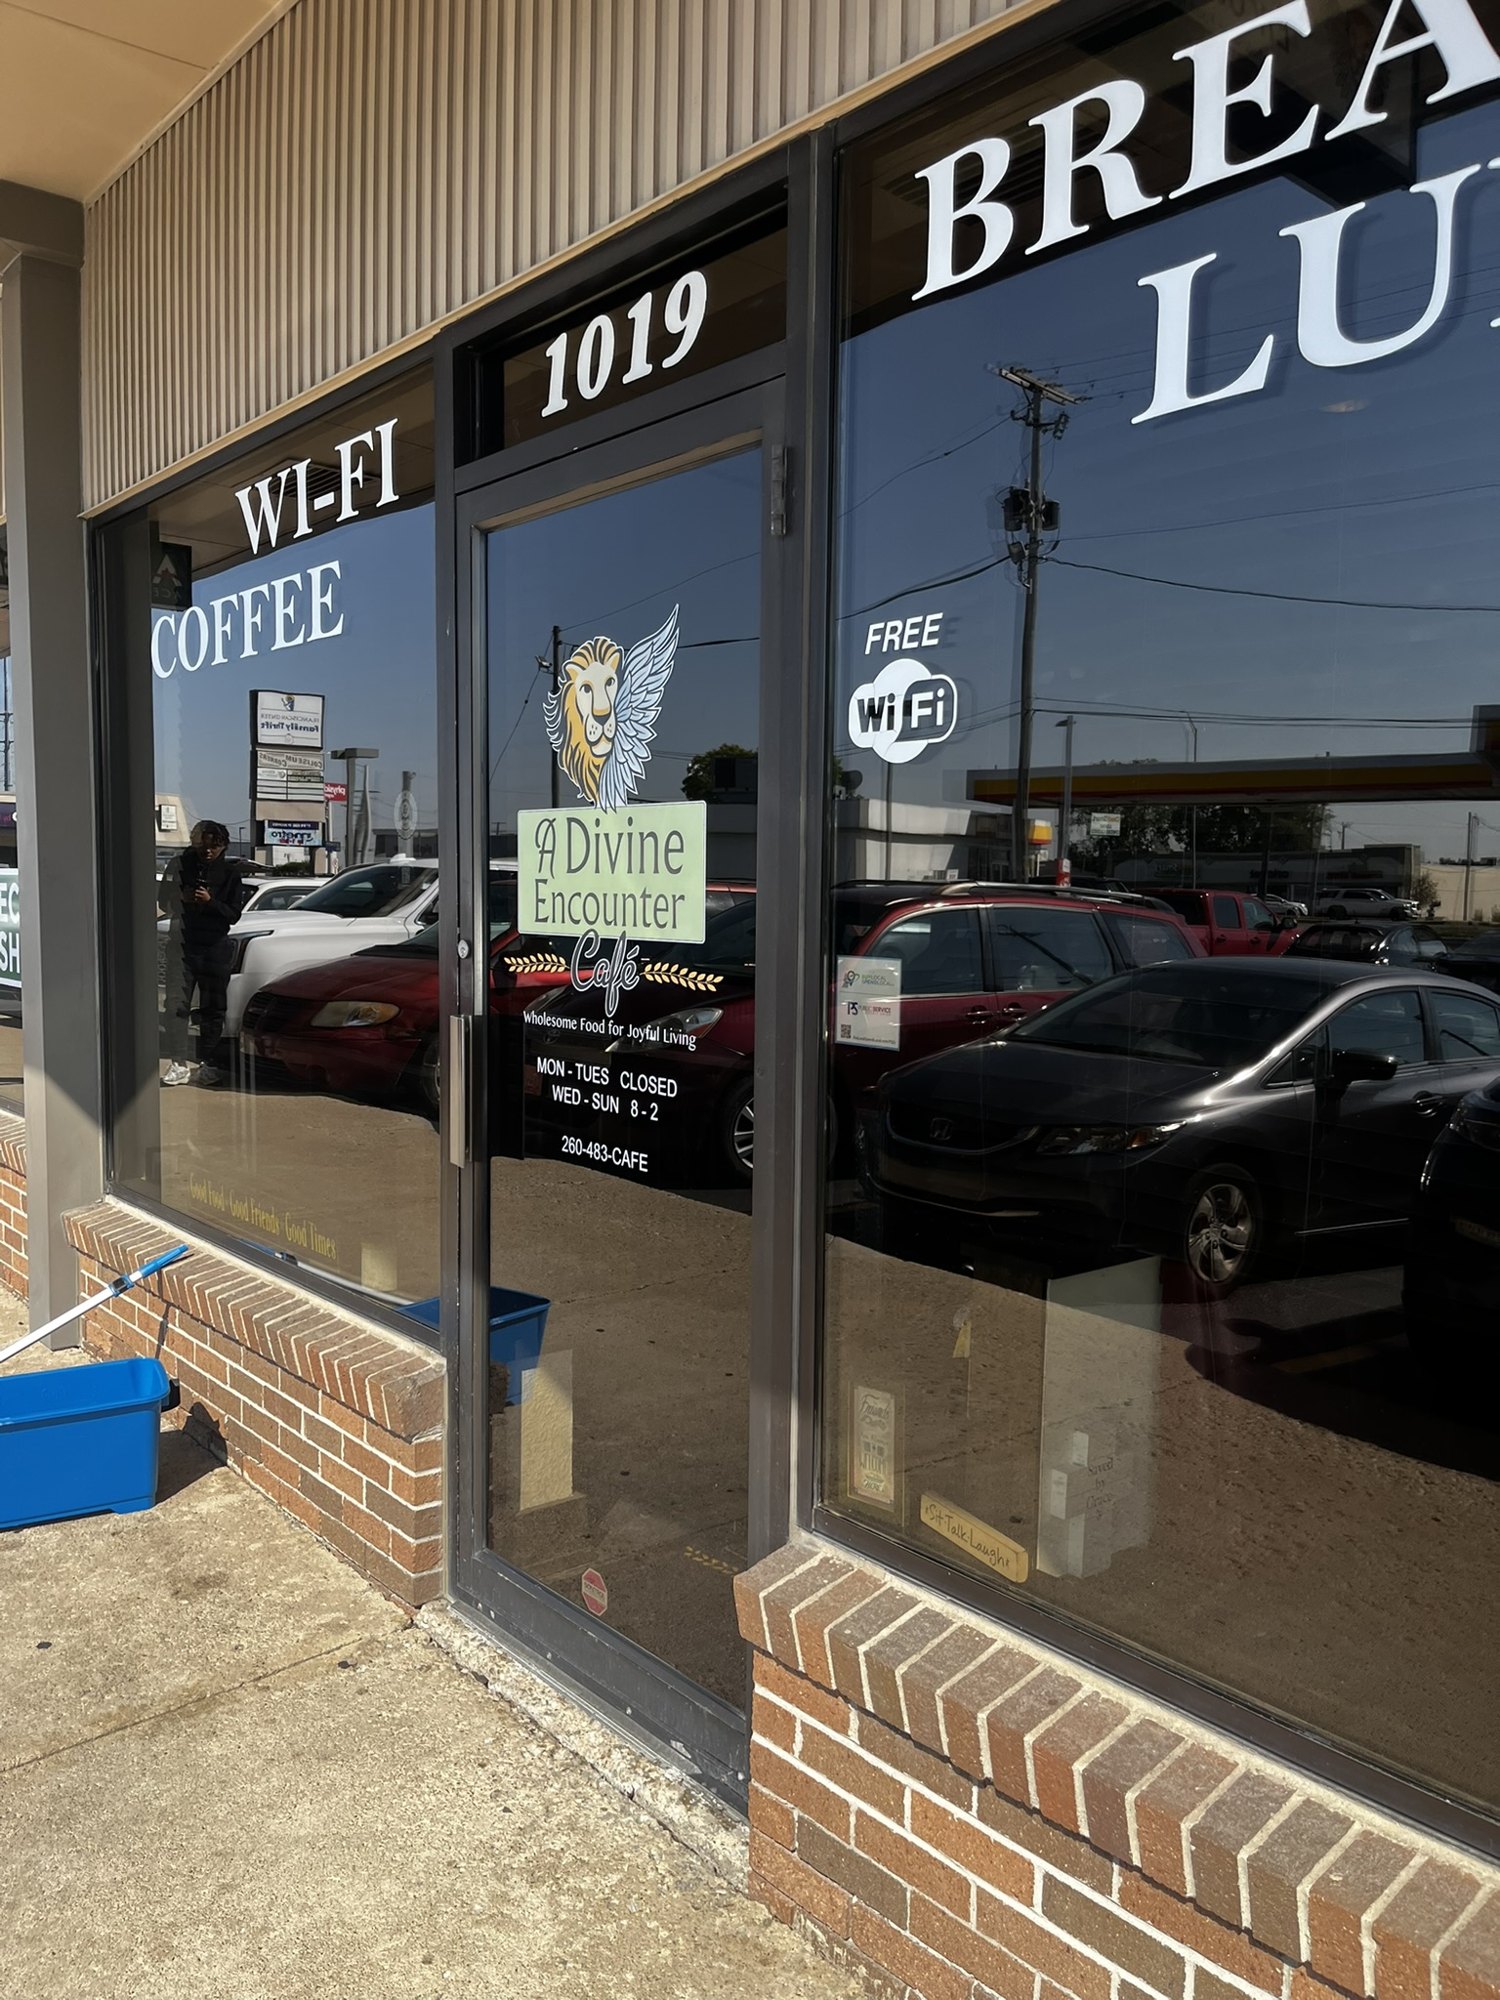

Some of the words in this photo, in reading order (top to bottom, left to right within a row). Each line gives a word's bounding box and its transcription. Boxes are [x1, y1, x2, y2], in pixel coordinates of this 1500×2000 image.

[911, 0, 1500, 301] BREA
[1130, 158, 1500, 425] LU
[541, 271, 708, 418] 1019
[235, 418, 400, 555] WI-FI
[150, 560, 345, 679] COFFEE
[864, 612, 944, 655] FREE
[535, 817, 557, 879] A
[565, 816, 685, 875] Divine
[534, 878, 686, 929] Encounter
[570, 929, 640, 1018] Café
[523, 1010, 577, 1030] Wholesome
[580, 1018, 605, 1034] Food
[608, 1020, 624, 1037] for
[627, 1024, 660, 1043] Joyful
[663, 1027, 697, 1051] Living
[537, 1056, 565, 1077] MON
[575, 1062, 609, 1085] TUES
[620, 1070, 678, 1098] CLOSED
[552, 1084, 581, 1105] WED
[592, 1092, 620, 1114] SUN
[561, 1135, 649, 1172] 260-483-CAFE
[190, 1172, 207, 1203] Good
[208, 1180, 225, 1211] Food
[229, 1189, 249, 1222] Good
[251, 1198, 280, 1236] Friends
[285, 1211, 307, 1247] Good
[308, 1220, 337, 1260] Times
